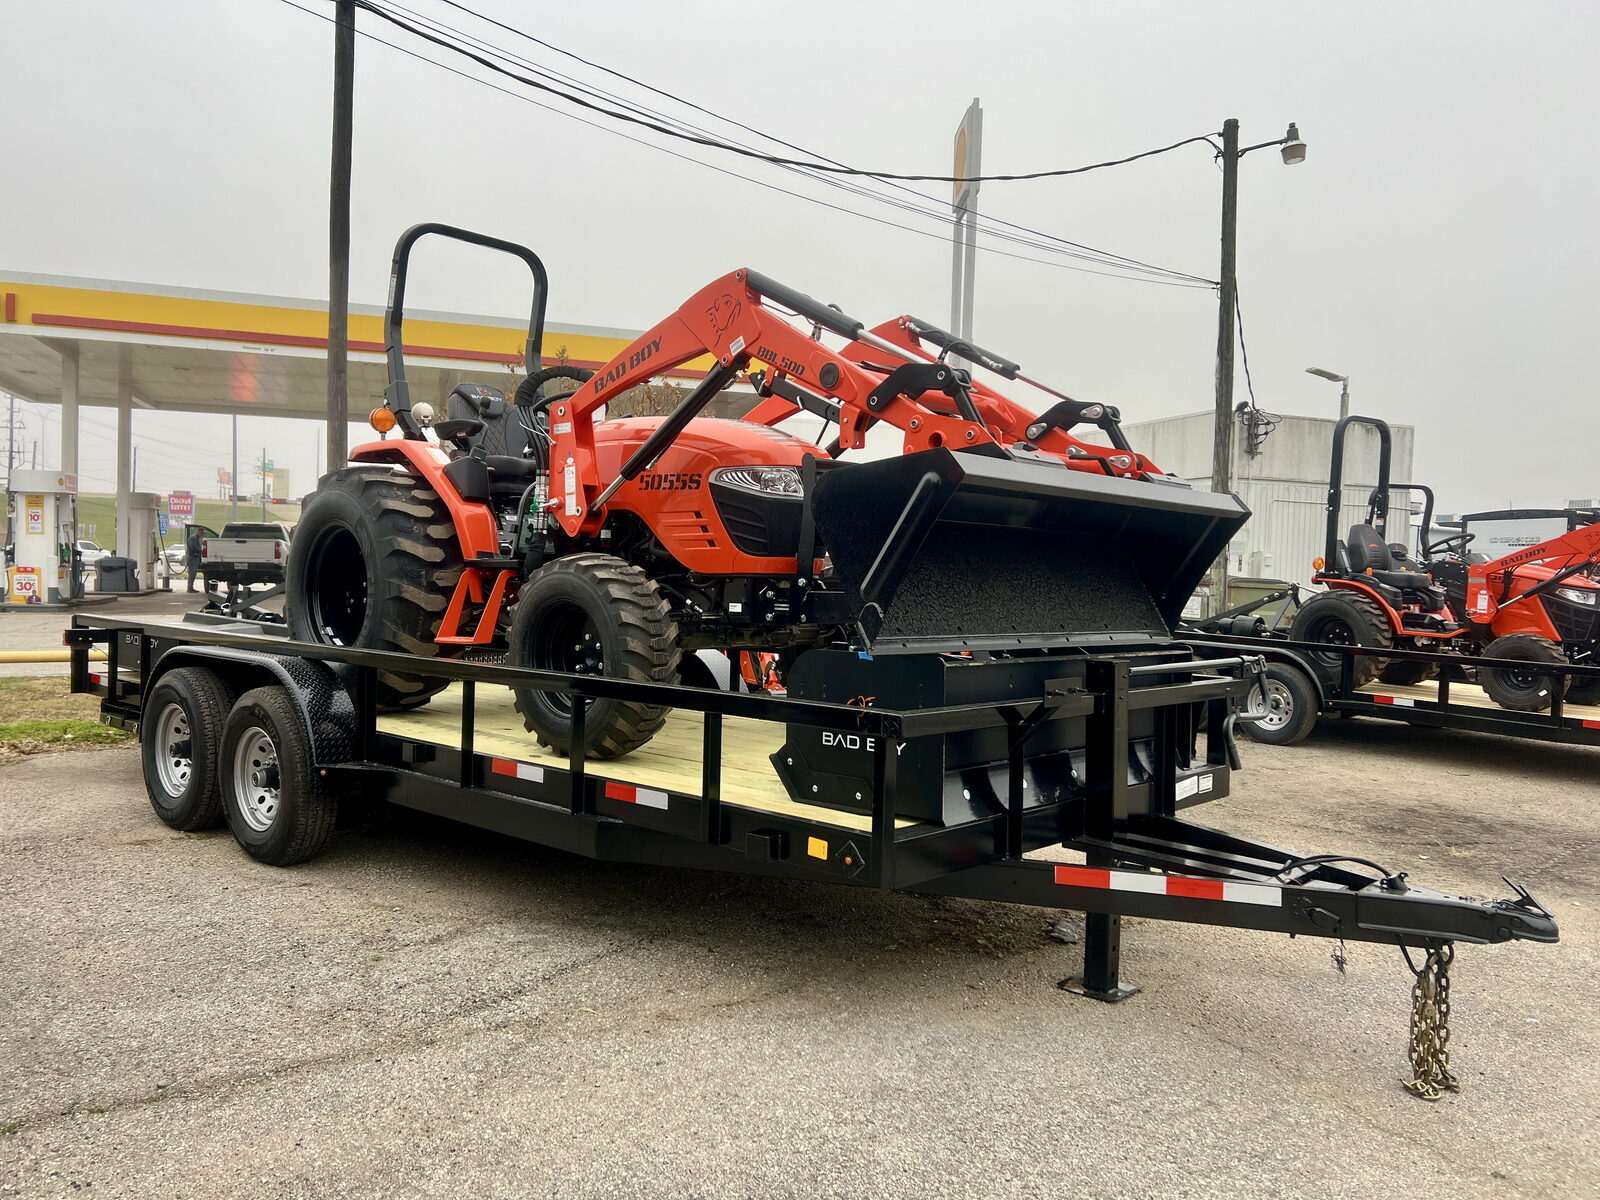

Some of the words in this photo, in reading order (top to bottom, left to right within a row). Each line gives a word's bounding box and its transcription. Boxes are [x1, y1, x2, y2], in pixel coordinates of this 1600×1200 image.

[593, 362, 627, 394] BAD
[629, 335, 663, 370] BOY
[757, 346, 777, 364] BBL
[780, 357, 805, 376] 500
[638, 473, 703, 491] 5055S
[1500, 554, 1523, 568] BAD
[1525, 546, 1547, 559] BOY
[125, 634, 139, 645] BAD
[822, 731, 860, 750] BAD
[866, 737, 907, 756] BY
